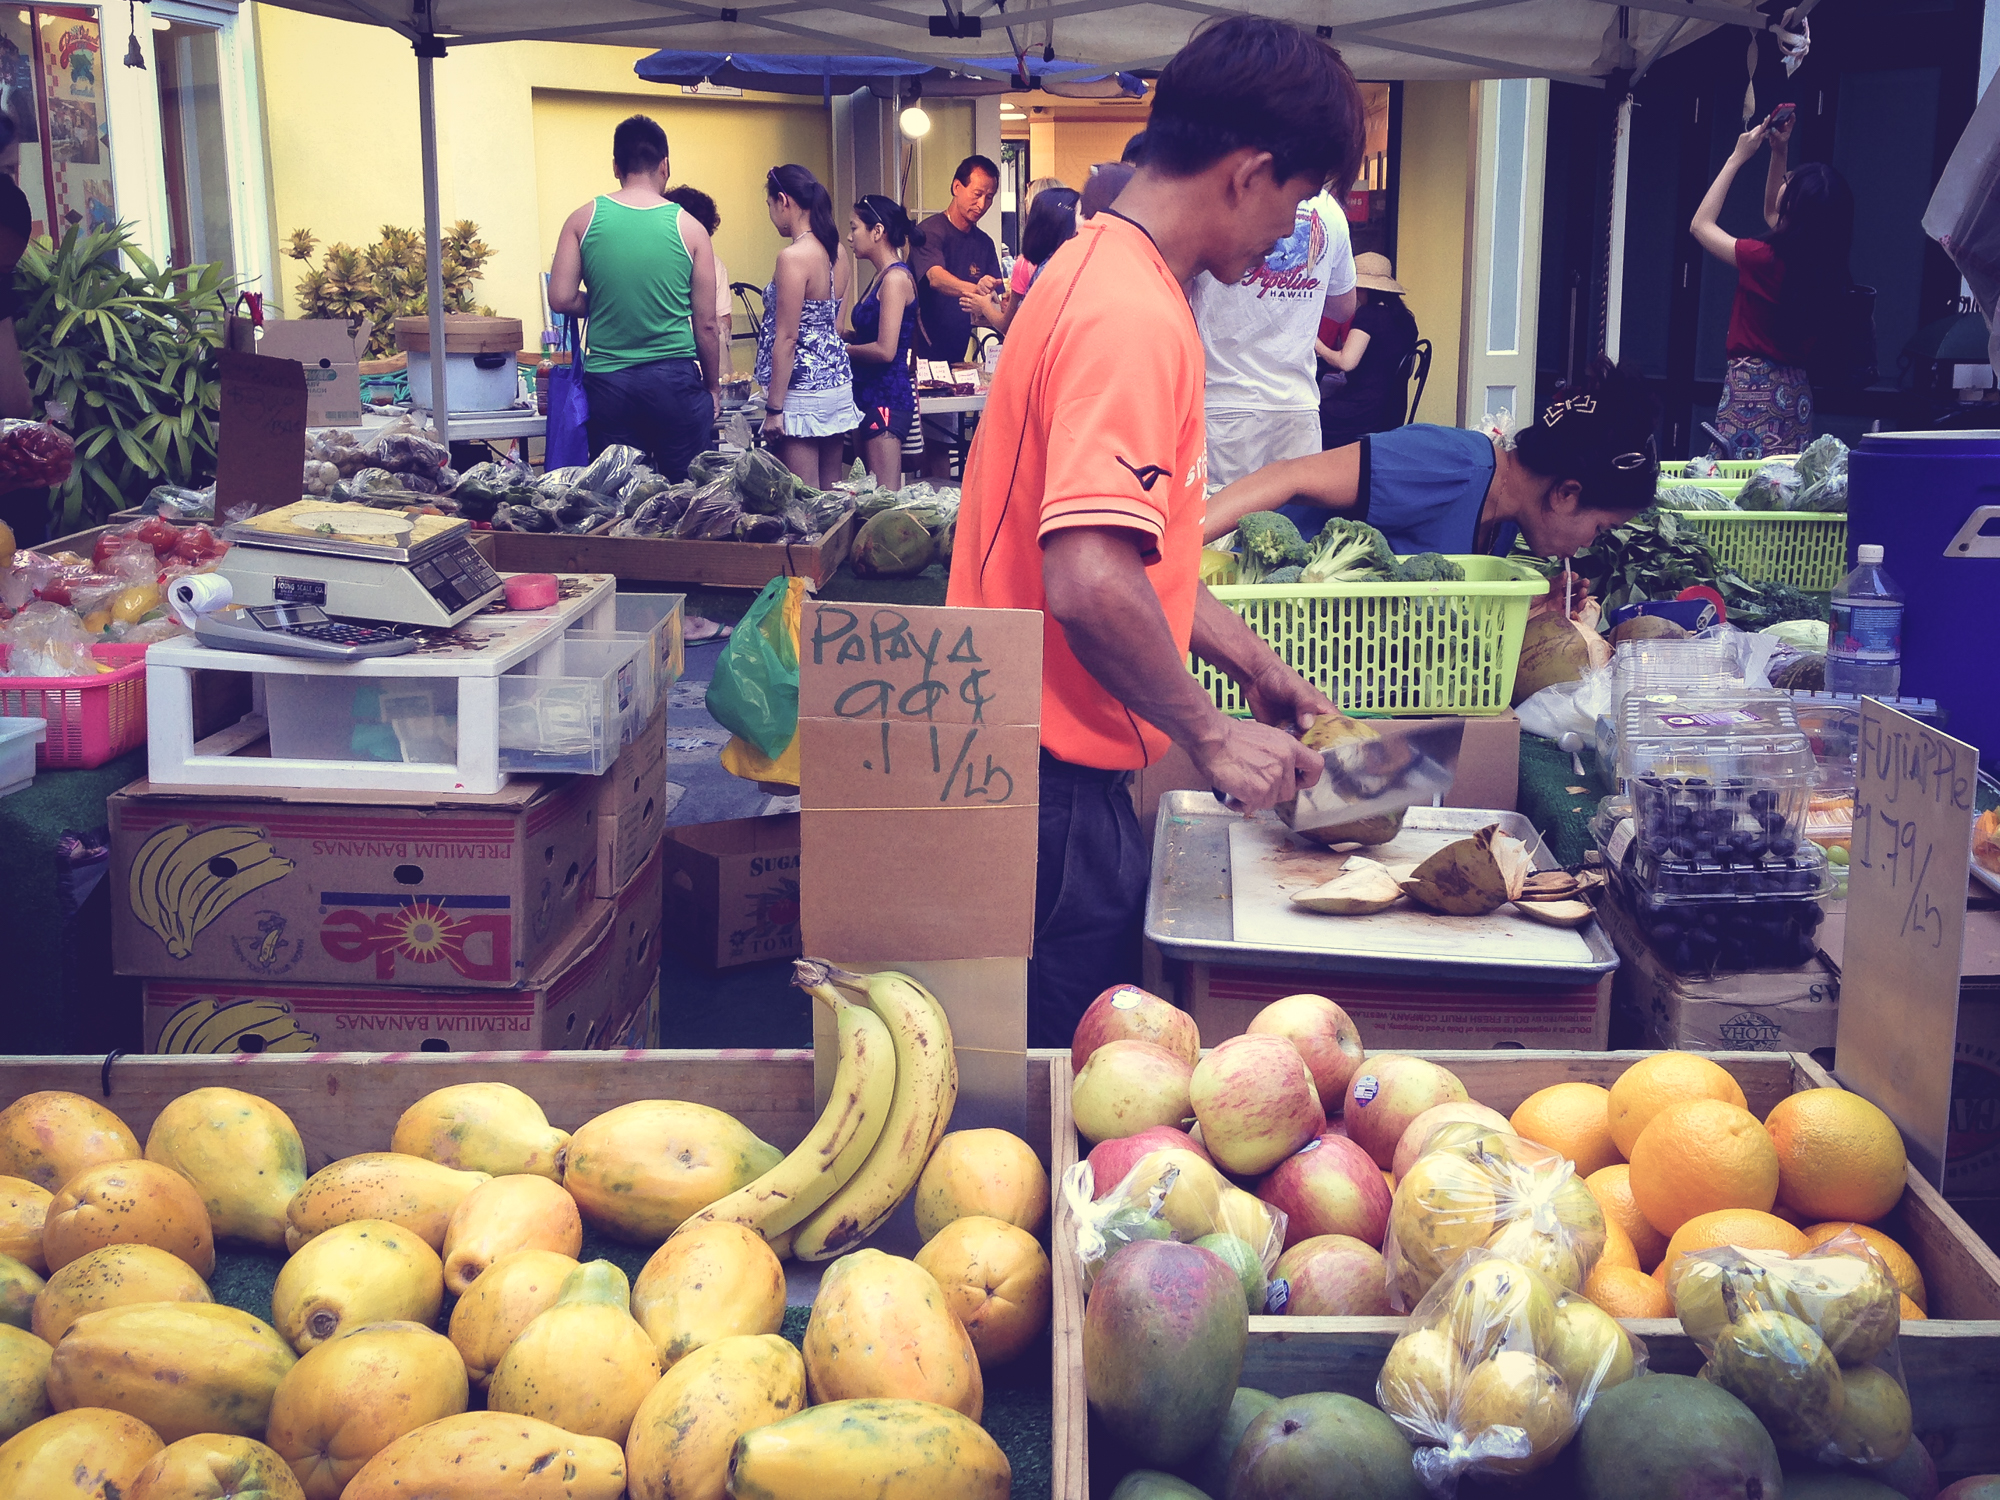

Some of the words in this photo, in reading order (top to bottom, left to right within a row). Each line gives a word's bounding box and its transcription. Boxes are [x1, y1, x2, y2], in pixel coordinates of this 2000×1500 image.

[1241, 264, 1321, 299] Pipeline
[1270, 290, 1313, 299] HAWAII
[312, 839, 407, 858] BANANAS
[415, 842, 512, 860] PREMIUM
[319, 902, 512, 982] Dole
[335, 1014, 429, 1031] BANANAS
[436, 1016, 532, 1032] PREMIUM
[1389, 1012, 1438, 1023] COMPANY,
[1439, 1014, 1468, 1023] FRUIT
[1470, 1015, 1502, 1024] FRESH
[1503, 1015, 1530, 1024] DOLE
[1720, 1026, 1780, 1040] ALOHA
